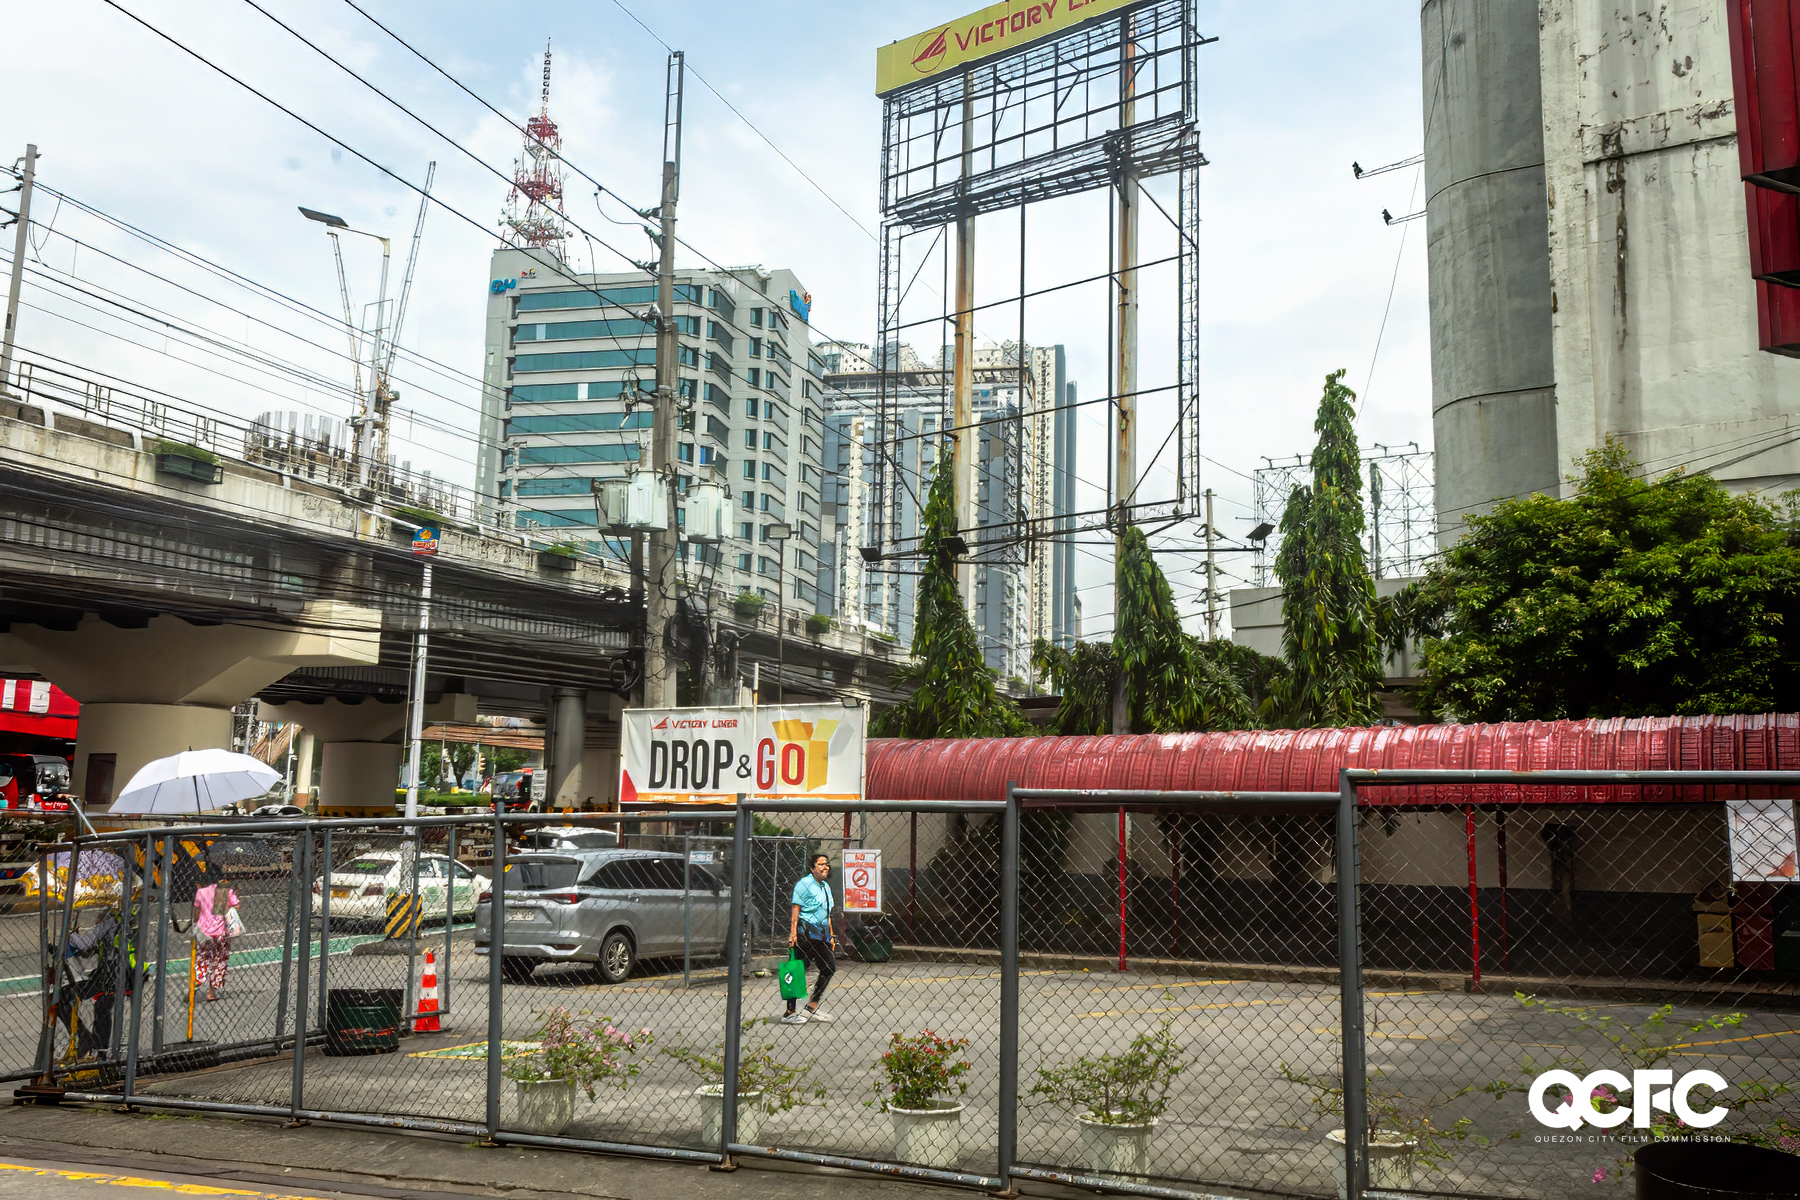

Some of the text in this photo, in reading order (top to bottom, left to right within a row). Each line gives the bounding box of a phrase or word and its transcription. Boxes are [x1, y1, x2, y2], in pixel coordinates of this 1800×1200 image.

[954, 0, 1058, 51] VICTORY
[648, 738, 805, 790] DROP & GO
